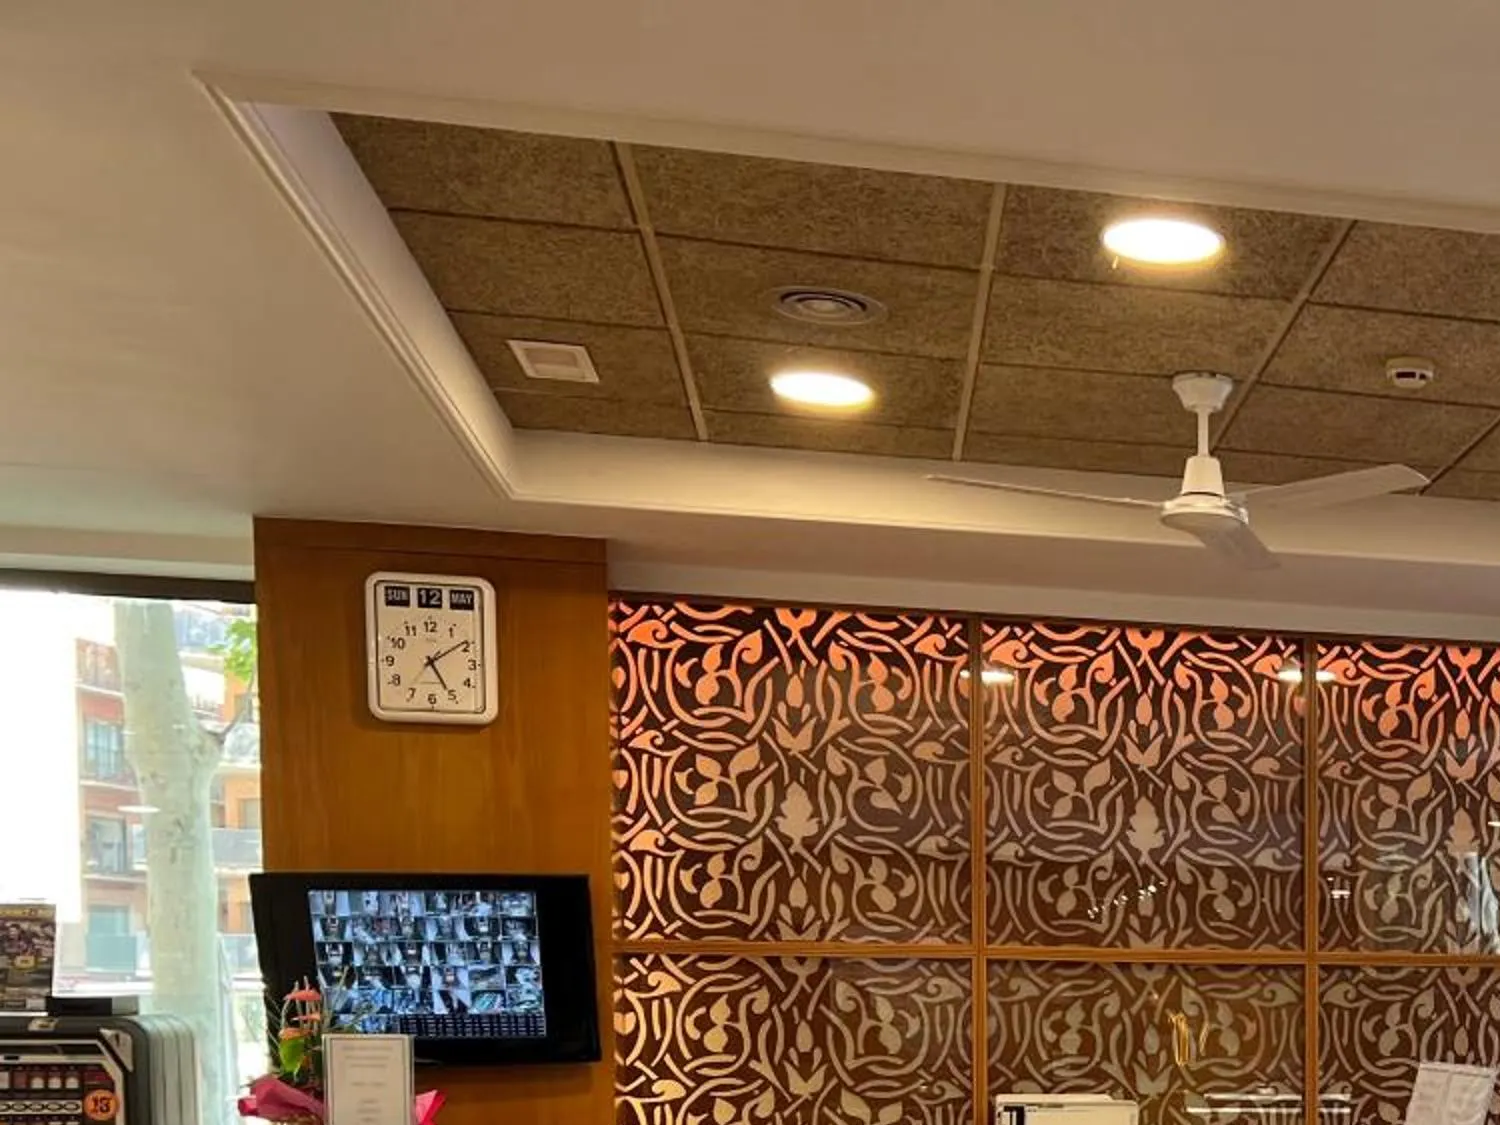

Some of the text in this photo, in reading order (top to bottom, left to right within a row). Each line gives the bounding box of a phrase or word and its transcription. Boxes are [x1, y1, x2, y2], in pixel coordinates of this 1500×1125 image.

[419, 589, 441, 605] 12
[451, 592, 473, 605] MAY
[405, 625, 417, 637] 11
[423, 621, 438, 633] 12
[391, 638, 405, 649] 10
[385, 656, 394, 667] 9
[467, 659, 476, 671] 3
[392, 674, 401, 686] 8
[463, 678, 472, 688] 4
[407, 687, 416, 700] 7
[427, 693, 436, 704] 6
[447, 690, 456, 701] 5
